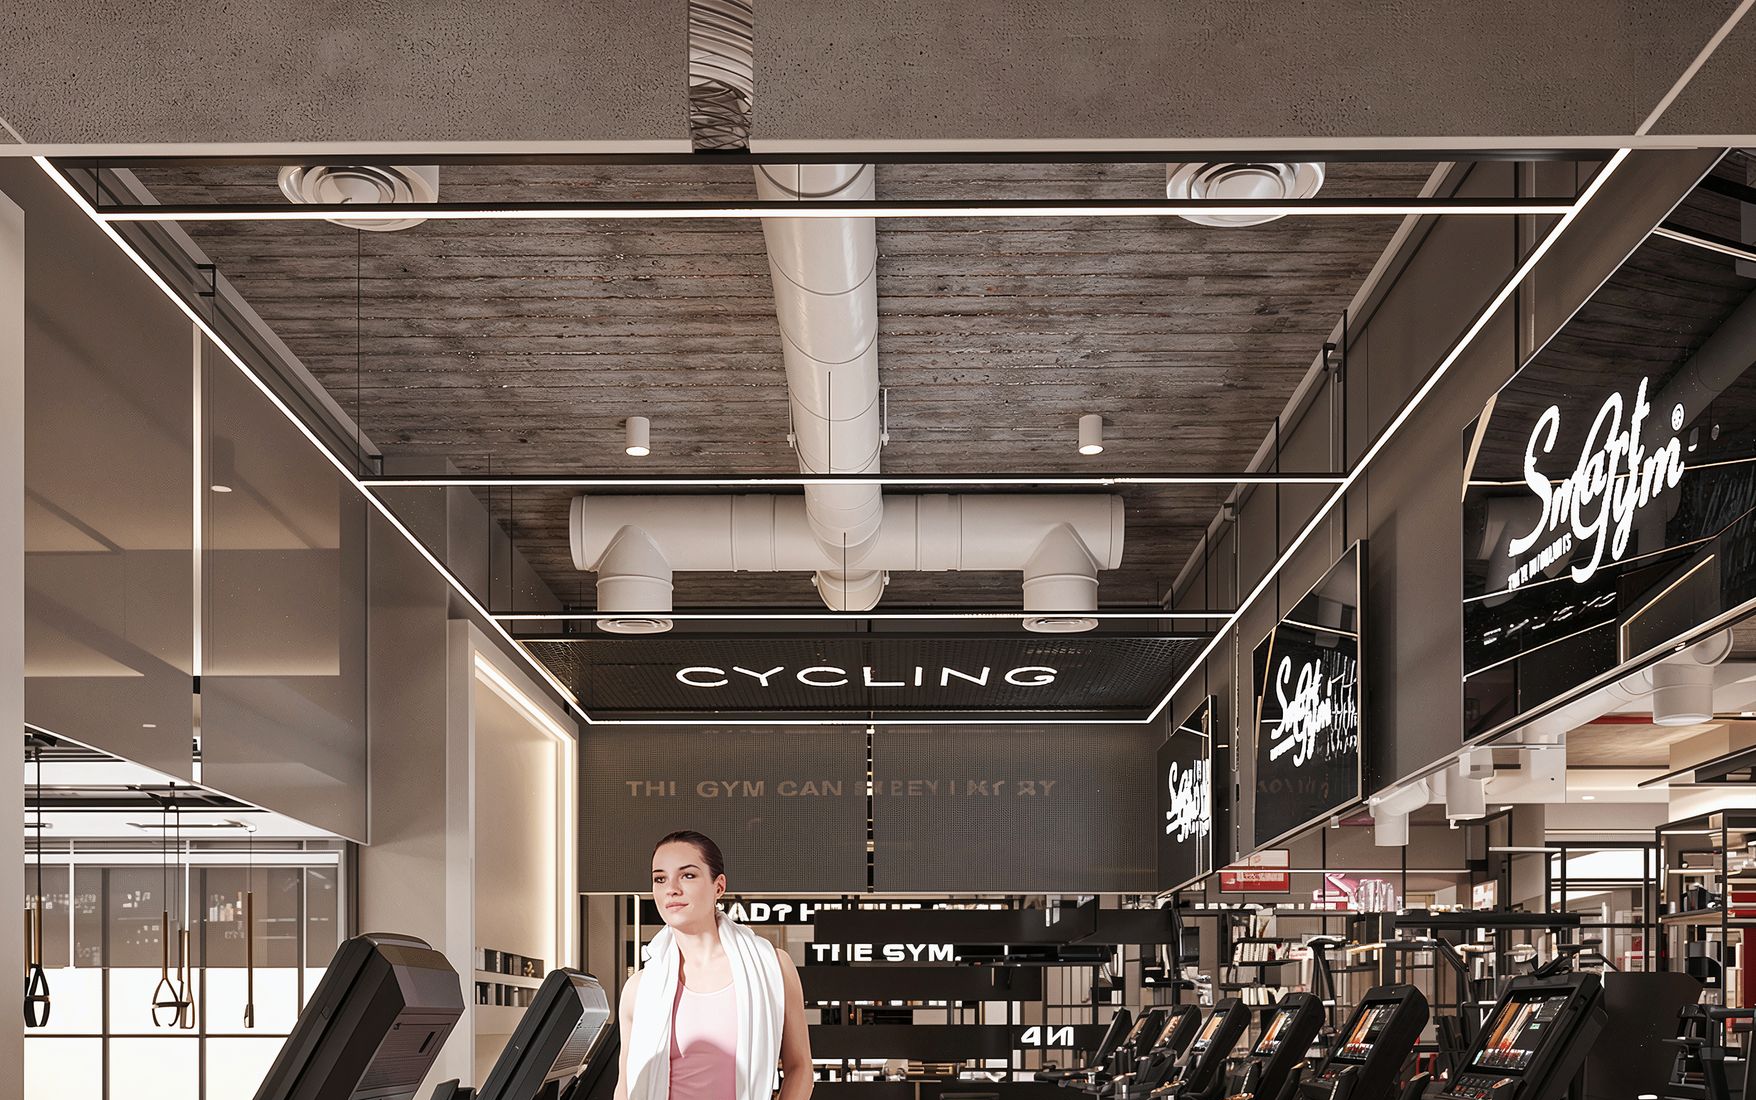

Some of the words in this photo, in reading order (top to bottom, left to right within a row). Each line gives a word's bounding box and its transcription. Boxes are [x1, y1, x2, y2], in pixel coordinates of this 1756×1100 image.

[675, 666, 1058, 688] CYCLING
[696, 780, 765, 798] GYM
[776, 780, 843, 798] CAN
